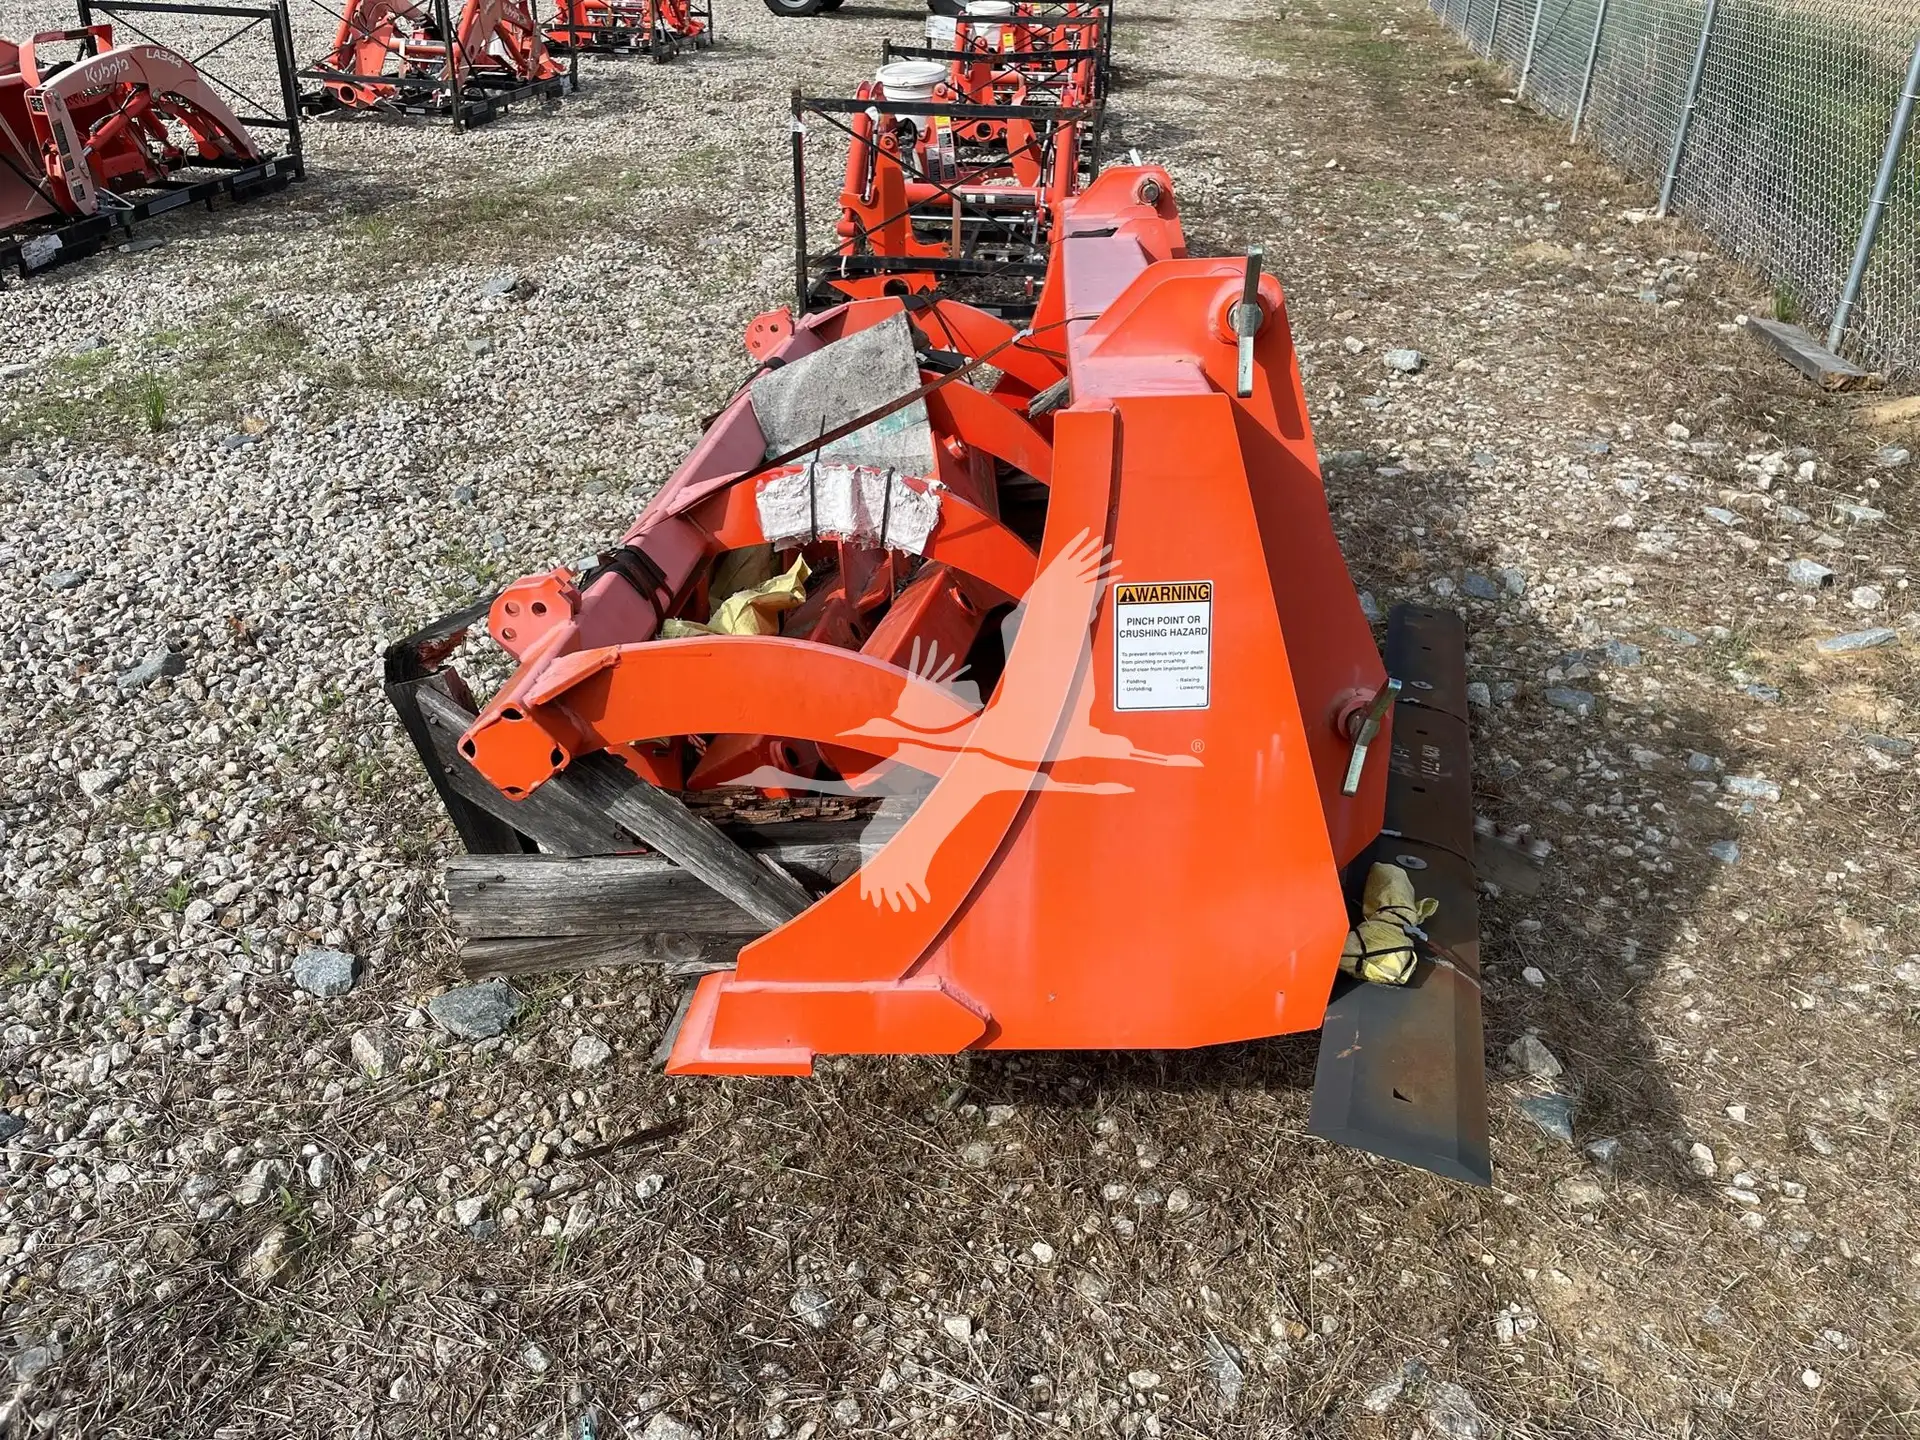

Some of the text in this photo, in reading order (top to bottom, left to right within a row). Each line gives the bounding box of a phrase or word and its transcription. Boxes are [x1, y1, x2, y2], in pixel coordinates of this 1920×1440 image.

[146, 48, 184, 69] LA344
[85, 56, 130, 83] Kubota
[1135, 585, 1209, 602] WARNING
[1126, 615, 1201, 626] PINCH POINT OR
[1119, 627, 1208, 638] CRUSHING HAZARD
